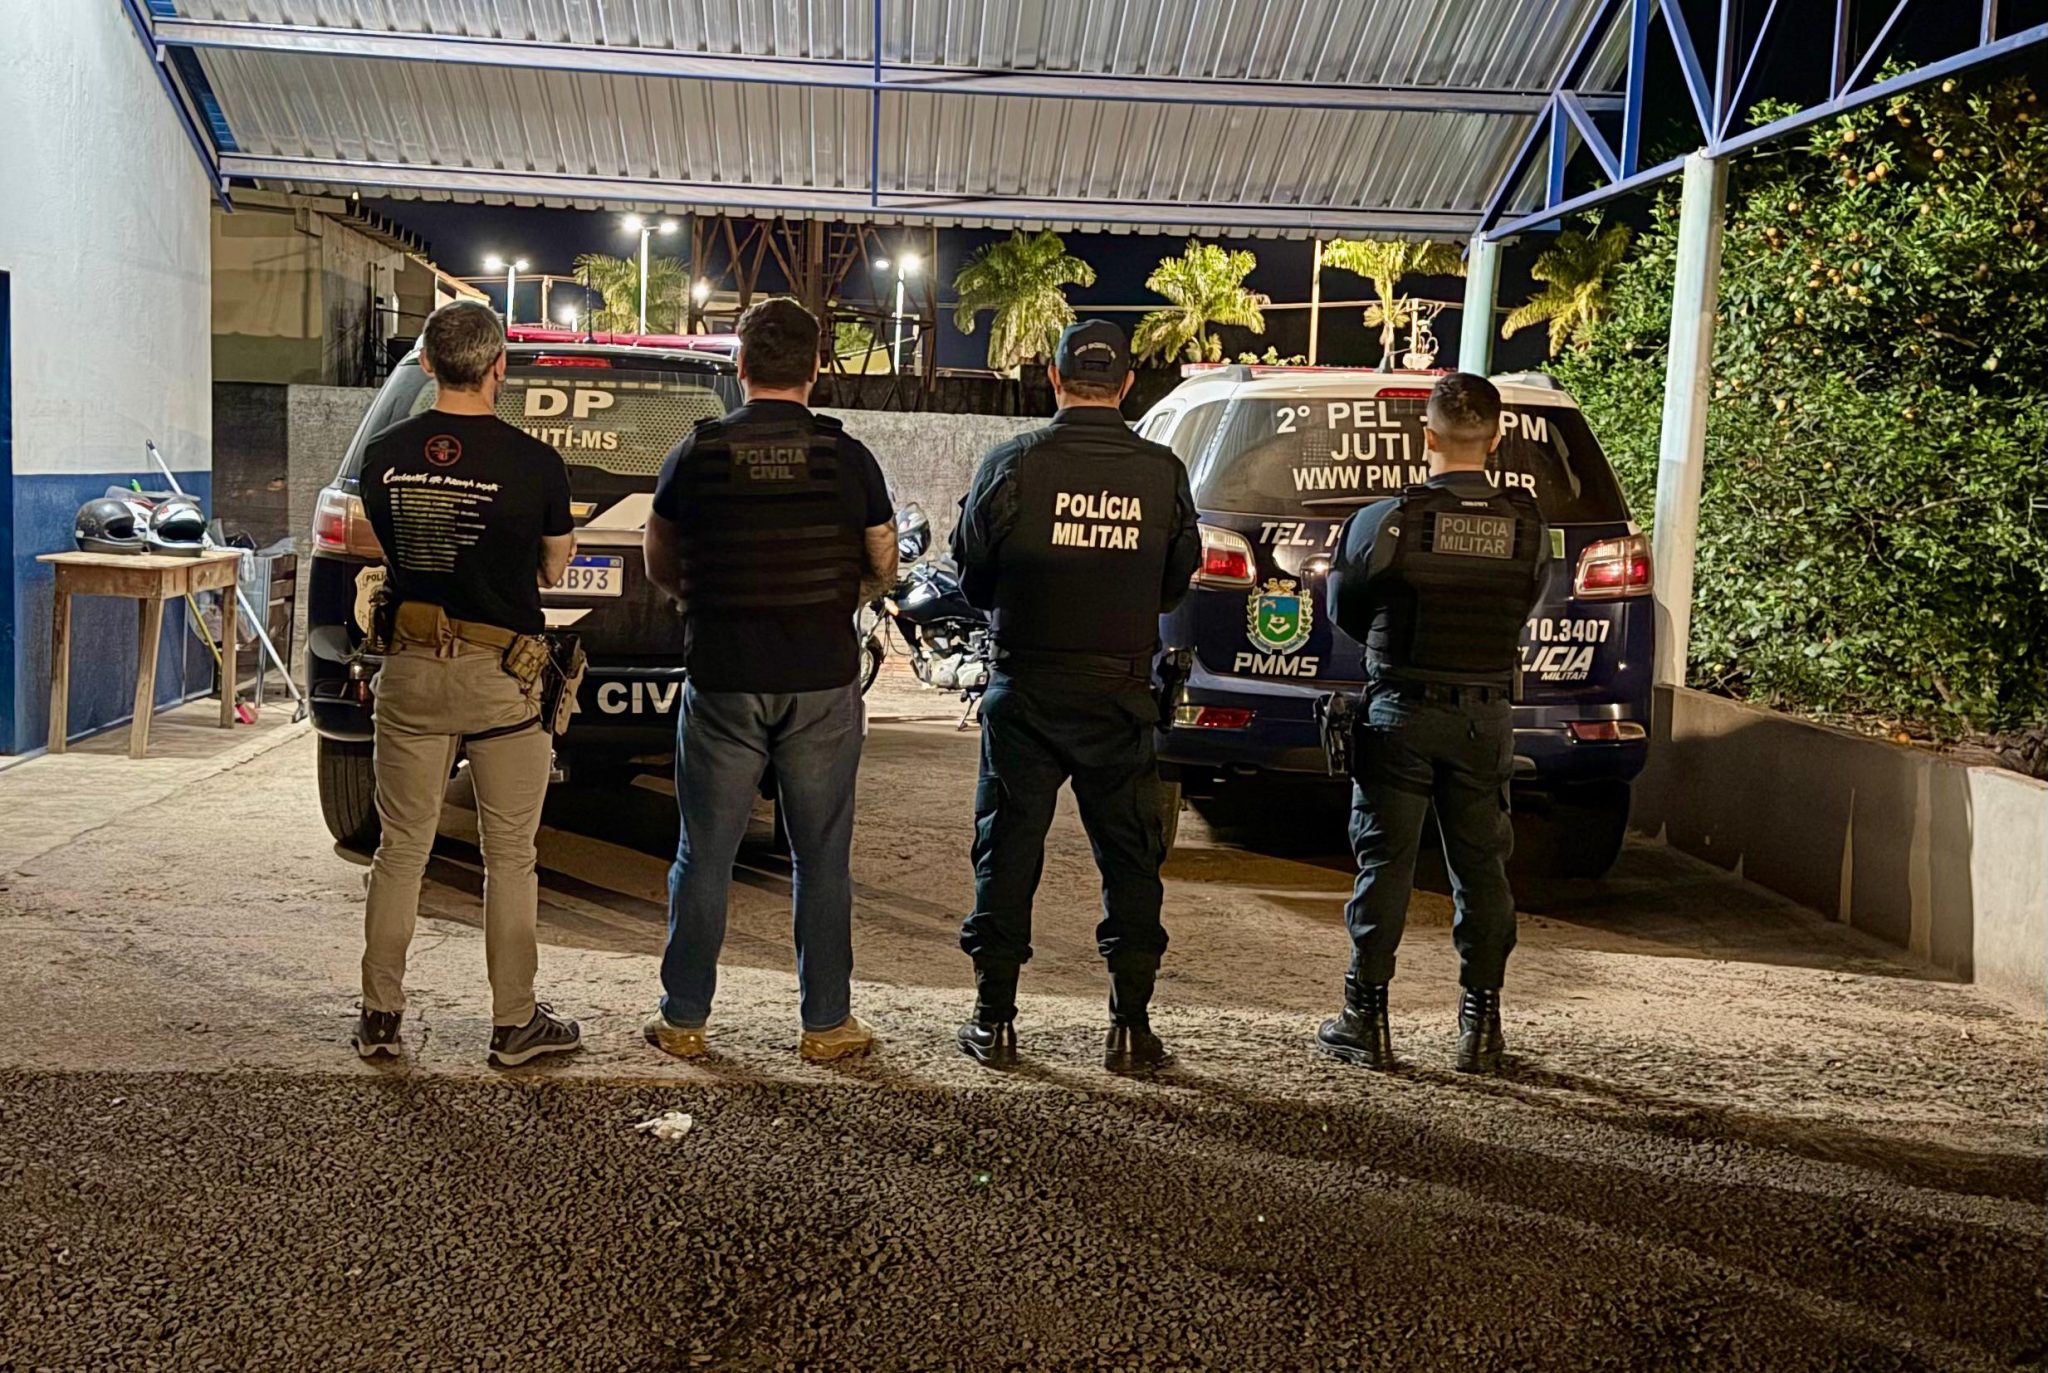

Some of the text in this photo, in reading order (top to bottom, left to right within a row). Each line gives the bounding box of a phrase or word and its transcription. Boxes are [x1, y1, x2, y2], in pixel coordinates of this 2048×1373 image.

[524, 388, 615, 418] DP
[1327, 401, 1402, 430] PEL
[523, 425, 618, 450] UTÍ-MS
[1330, 433, 1411, 461] JUTI
[735, 446, 808, 465] POLÍCIA
[750, 465, 795, 480] CIVIL
[1055, 490, 1142, 521] POLÍCIA
[1052, 522, 1140, 550] MILITAR
[1259, 522, 1315, 546] TEL.
[1441, 518, 1509, 537] POLÍCIA
[1440, 535, 1506, 554] MILITAR
[1527, 618, 1610, 643] 10.3407
[1233, 652, 1320, 677] PMMS
[1517, 646, 1595, 672] LICIA
[1541, 671, 1588, 681] MILITAR
